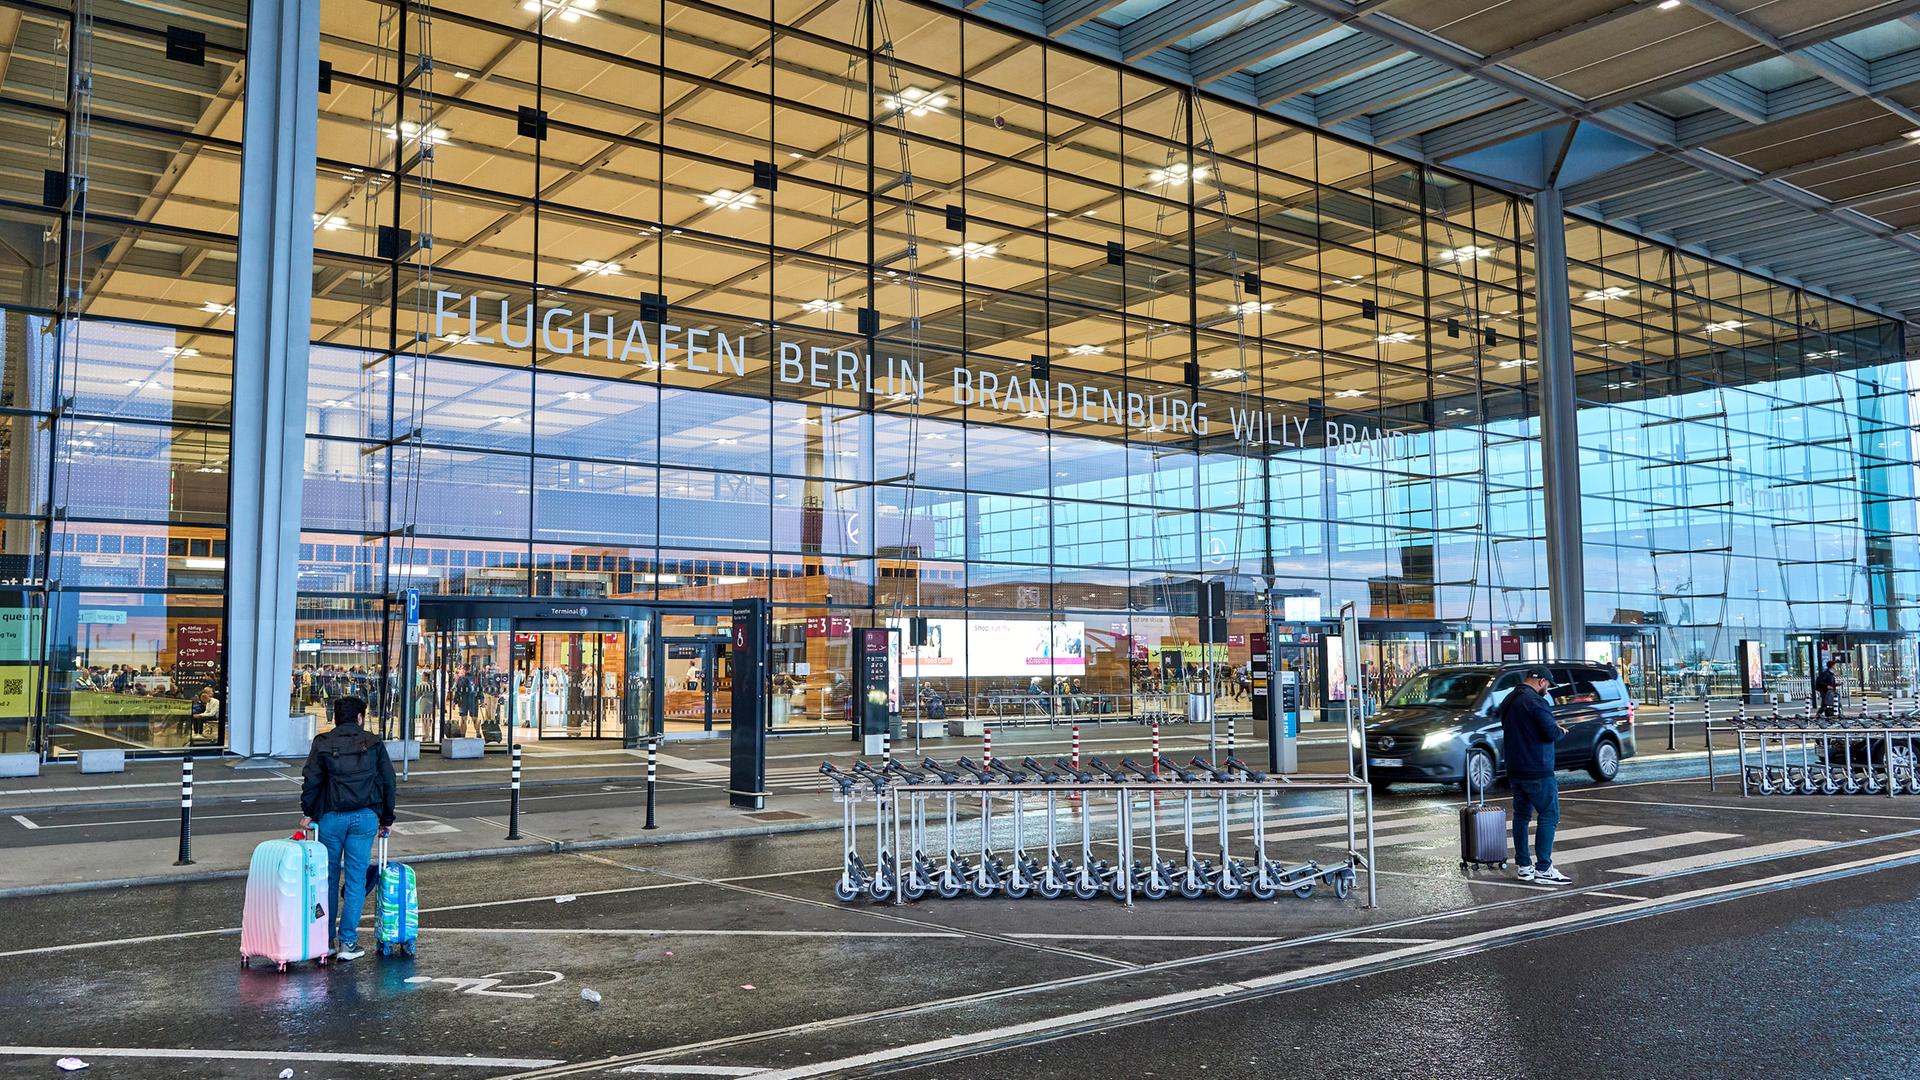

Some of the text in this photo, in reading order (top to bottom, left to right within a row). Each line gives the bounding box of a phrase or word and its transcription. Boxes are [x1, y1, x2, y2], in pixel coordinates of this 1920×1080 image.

[435, 290, 1421, 462] FLUGHAFEN BERLIN BRANDENBURG WILLY BRANDT
[410, 593, 417, 620] P
[820, 617, 827, 633] 3
[844, 617, 852, 633] 3
[1121, 623, 1128, 637] 3
